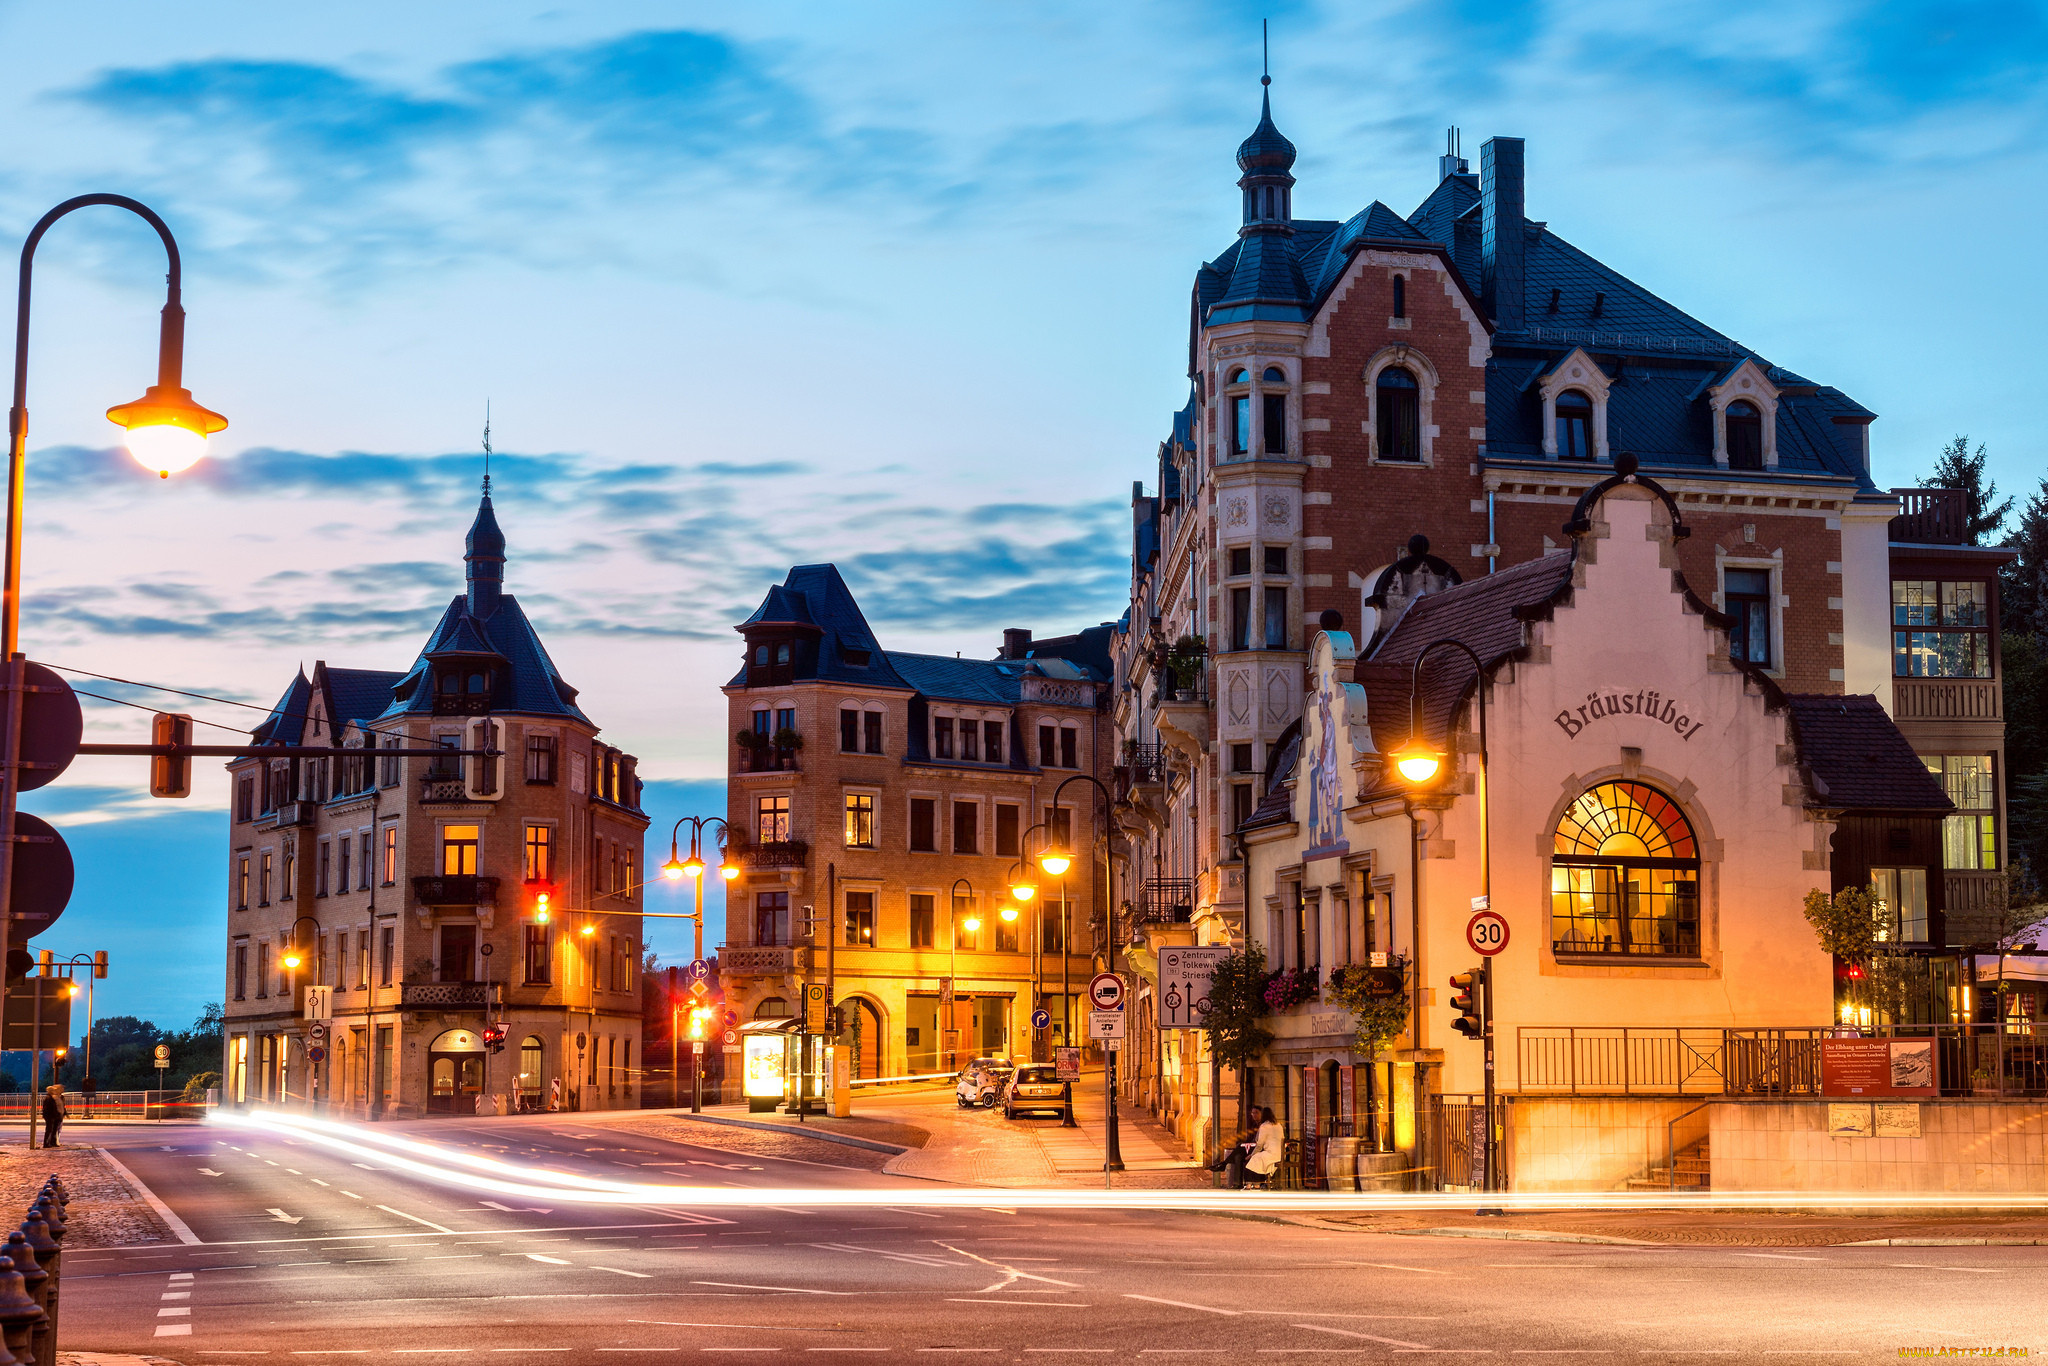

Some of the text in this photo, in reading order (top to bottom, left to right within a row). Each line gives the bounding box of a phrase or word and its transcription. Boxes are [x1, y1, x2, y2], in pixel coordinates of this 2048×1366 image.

[1554, 689, 1704, 742] Bräustübel
[1475, 923, 1501, 944] 30
[1182, 951, 1216, 959] Zentrum
[1182, 971, 1213, 979] Striese
[1312, 1014, 1346, 1034] Bräustübel
[1869, 1043, 1887, 1051] Dampf
